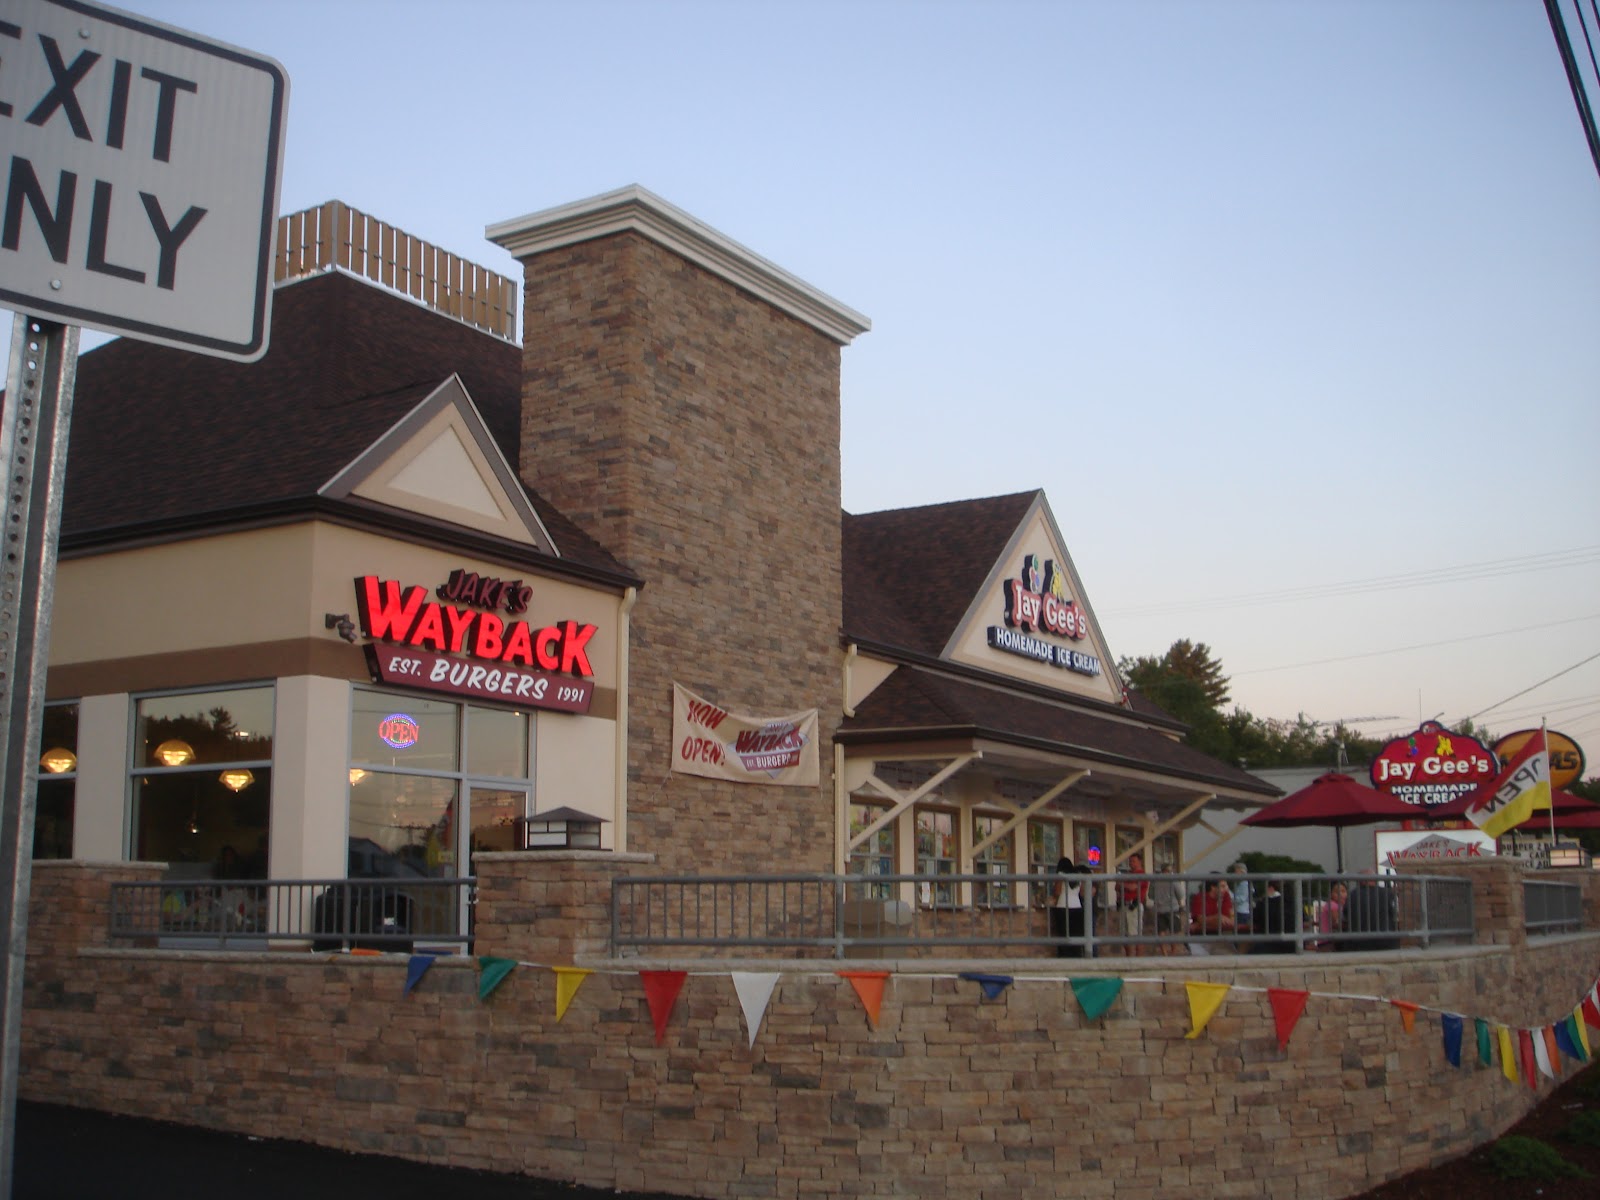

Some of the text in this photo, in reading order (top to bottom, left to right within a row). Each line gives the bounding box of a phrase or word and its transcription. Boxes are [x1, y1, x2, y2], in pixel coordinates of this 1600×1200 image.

[446, 568, 533, 613] JAKE'S
[1014, 583, 1087, 636] Jay Gee's
[360, 575, 598, 677] WAYBACK
[995, 627, 1101, 675] HOMEMADE ICE CREAM
[388, 656, 585, 703] EST. BURGERS 1991
[378, 719, 420, 743] OPEN
[687, 699, 728, 730] NOW
[1380, 755, 1489, 781] Jay Gee's
[1400, 792, 1464, 804] ICE CREA
